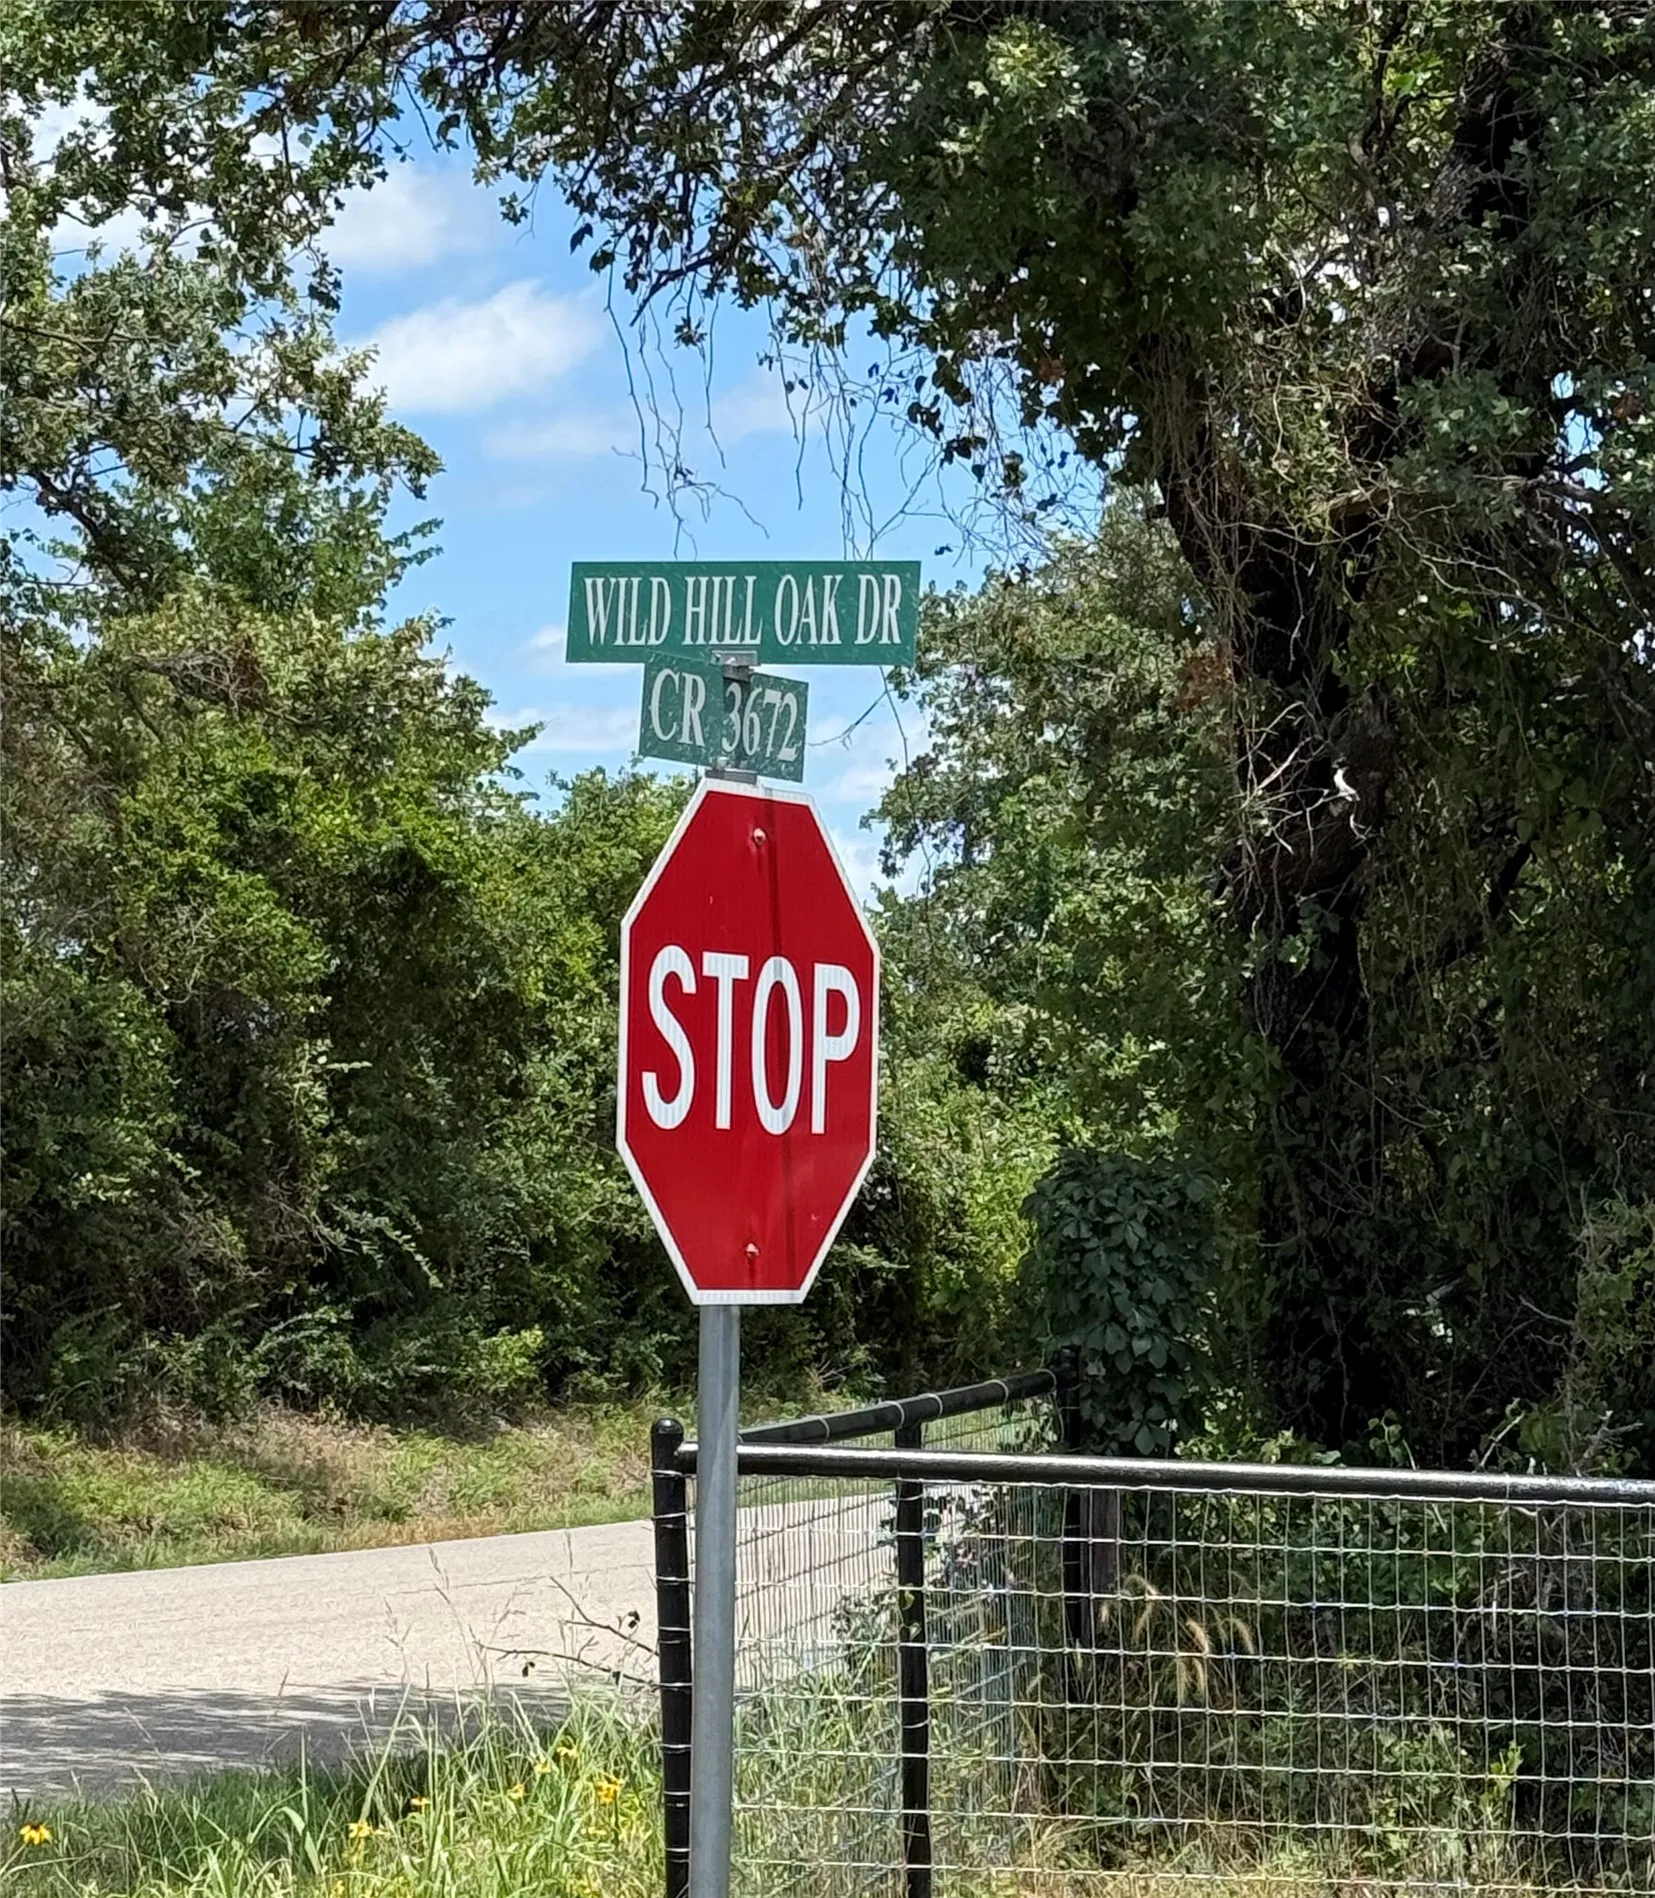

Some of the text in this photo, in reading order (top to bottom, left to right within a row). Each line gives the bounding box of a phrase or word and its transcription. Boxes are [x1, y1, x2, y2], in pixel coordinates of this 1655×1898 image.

[584, 573, 902, 646] WILD HILL OAK DR
[650, 668, 798, 762] CR 3672
[642, 944, 861, 1136] STOP
